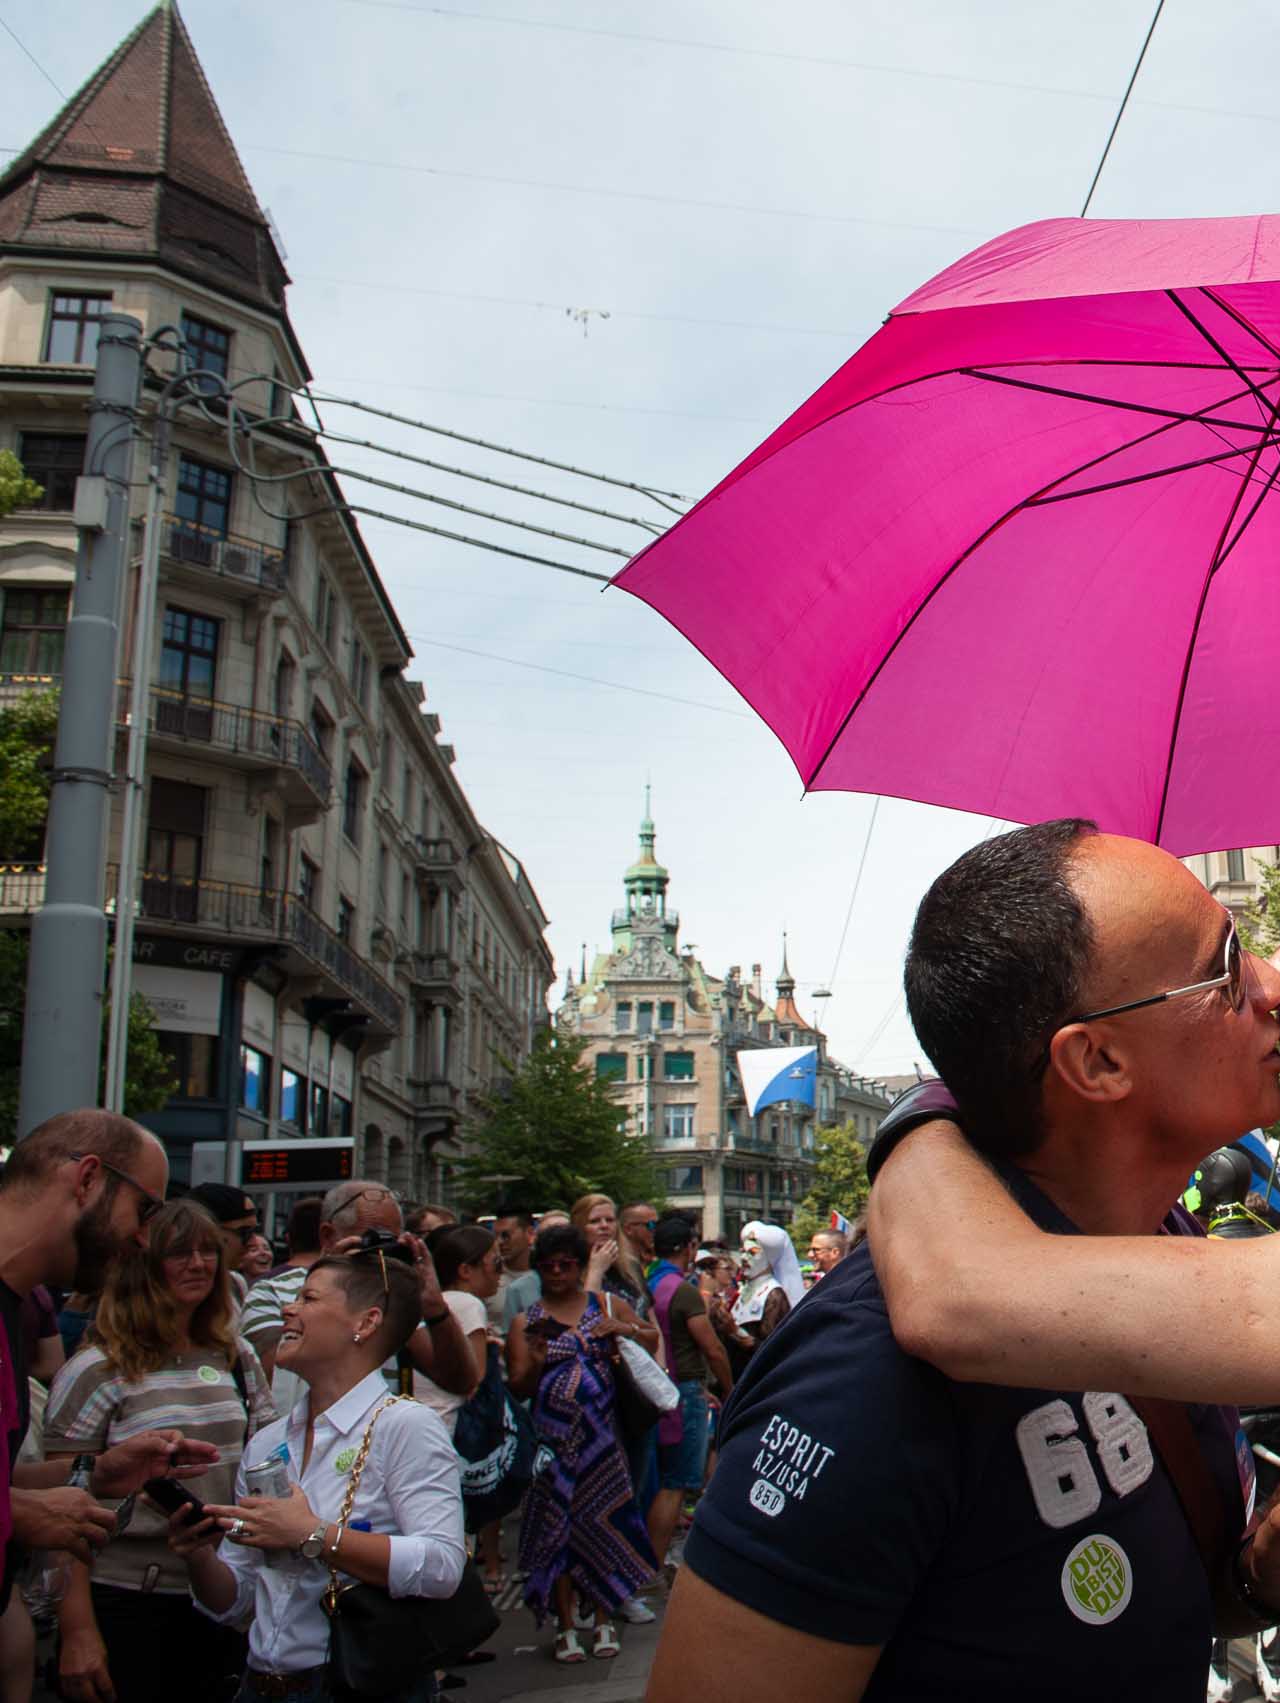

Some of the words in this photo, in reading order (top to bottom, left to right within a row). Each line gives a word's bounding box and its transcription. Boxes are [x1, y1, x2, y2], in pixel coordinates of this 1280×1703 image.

[760, 1415, 835, 1478] ESPRIT
[1016, 1391, 1154, 1527] 68
[752, 1448, 809, 1500] AZ/USA
[755, 1484, 781, 1511] 850
[1071, 1540, 1104, 1583] DU
[1088, 1553, 1118, 1592] BIST
[1091, 1574, 1125, 1616] DU
